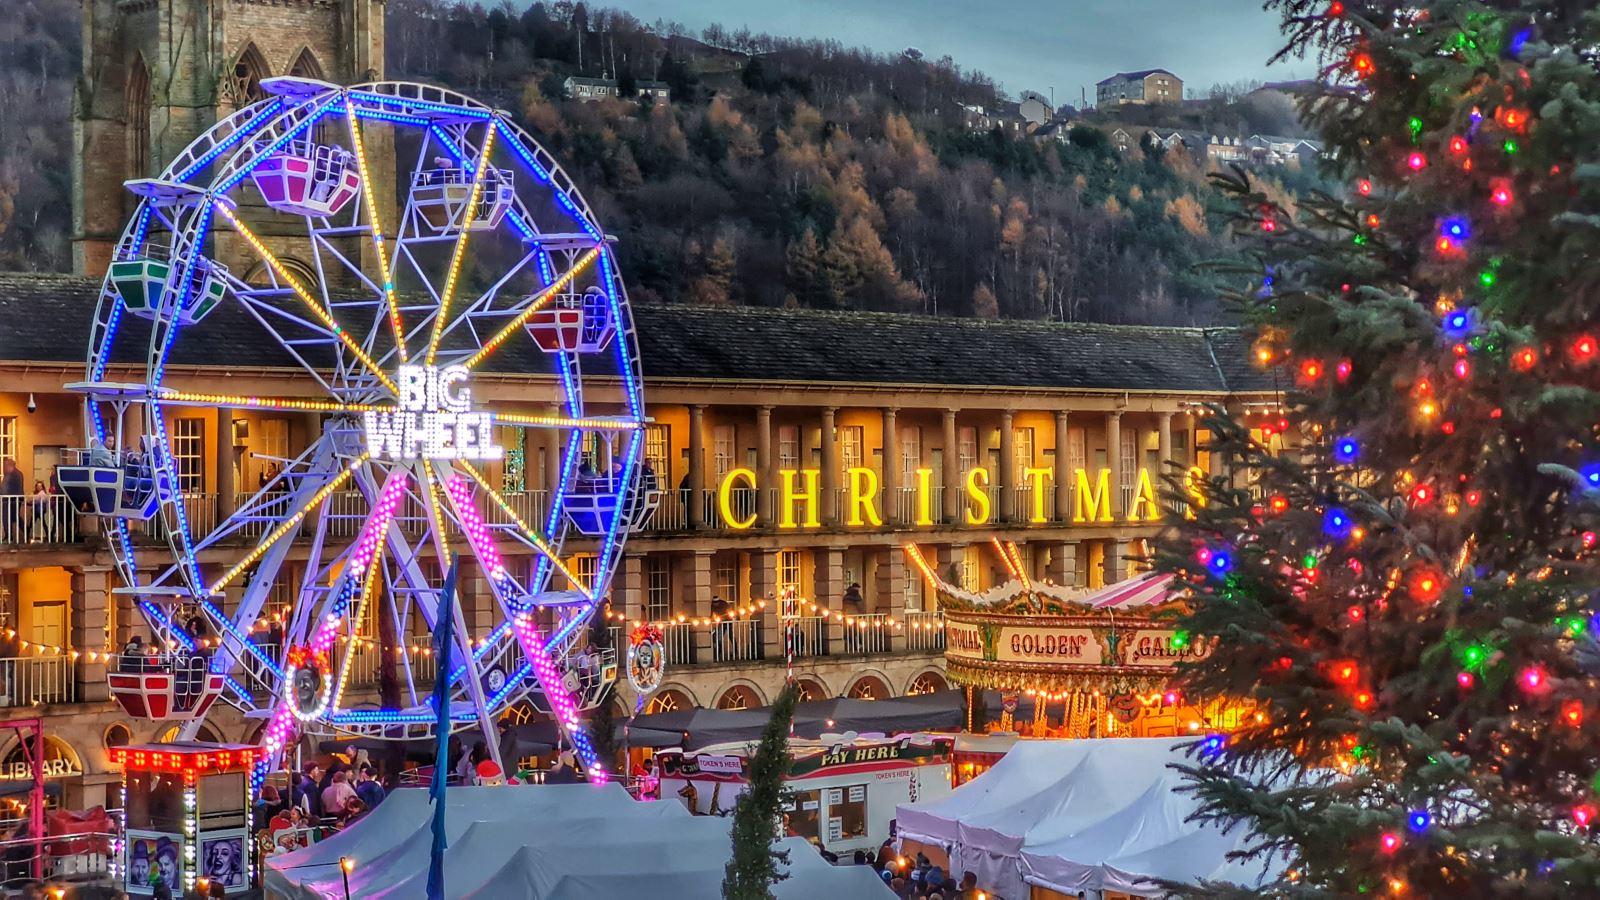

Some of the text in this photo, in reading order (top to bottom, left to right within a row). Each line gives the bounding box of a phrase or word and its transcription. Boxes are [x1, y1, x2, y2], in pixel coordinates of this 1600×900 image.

[399, 364, 471, 412] BIG
[364, 411, 503, 459] WHEEL
[719, 467, 1206, 529] CHRISTMAS
[1010, 633, 1083, 657] GOLDEN
[821, 746, 899, 767] PAY HERE
[897, 769, 911, 778] HERE
